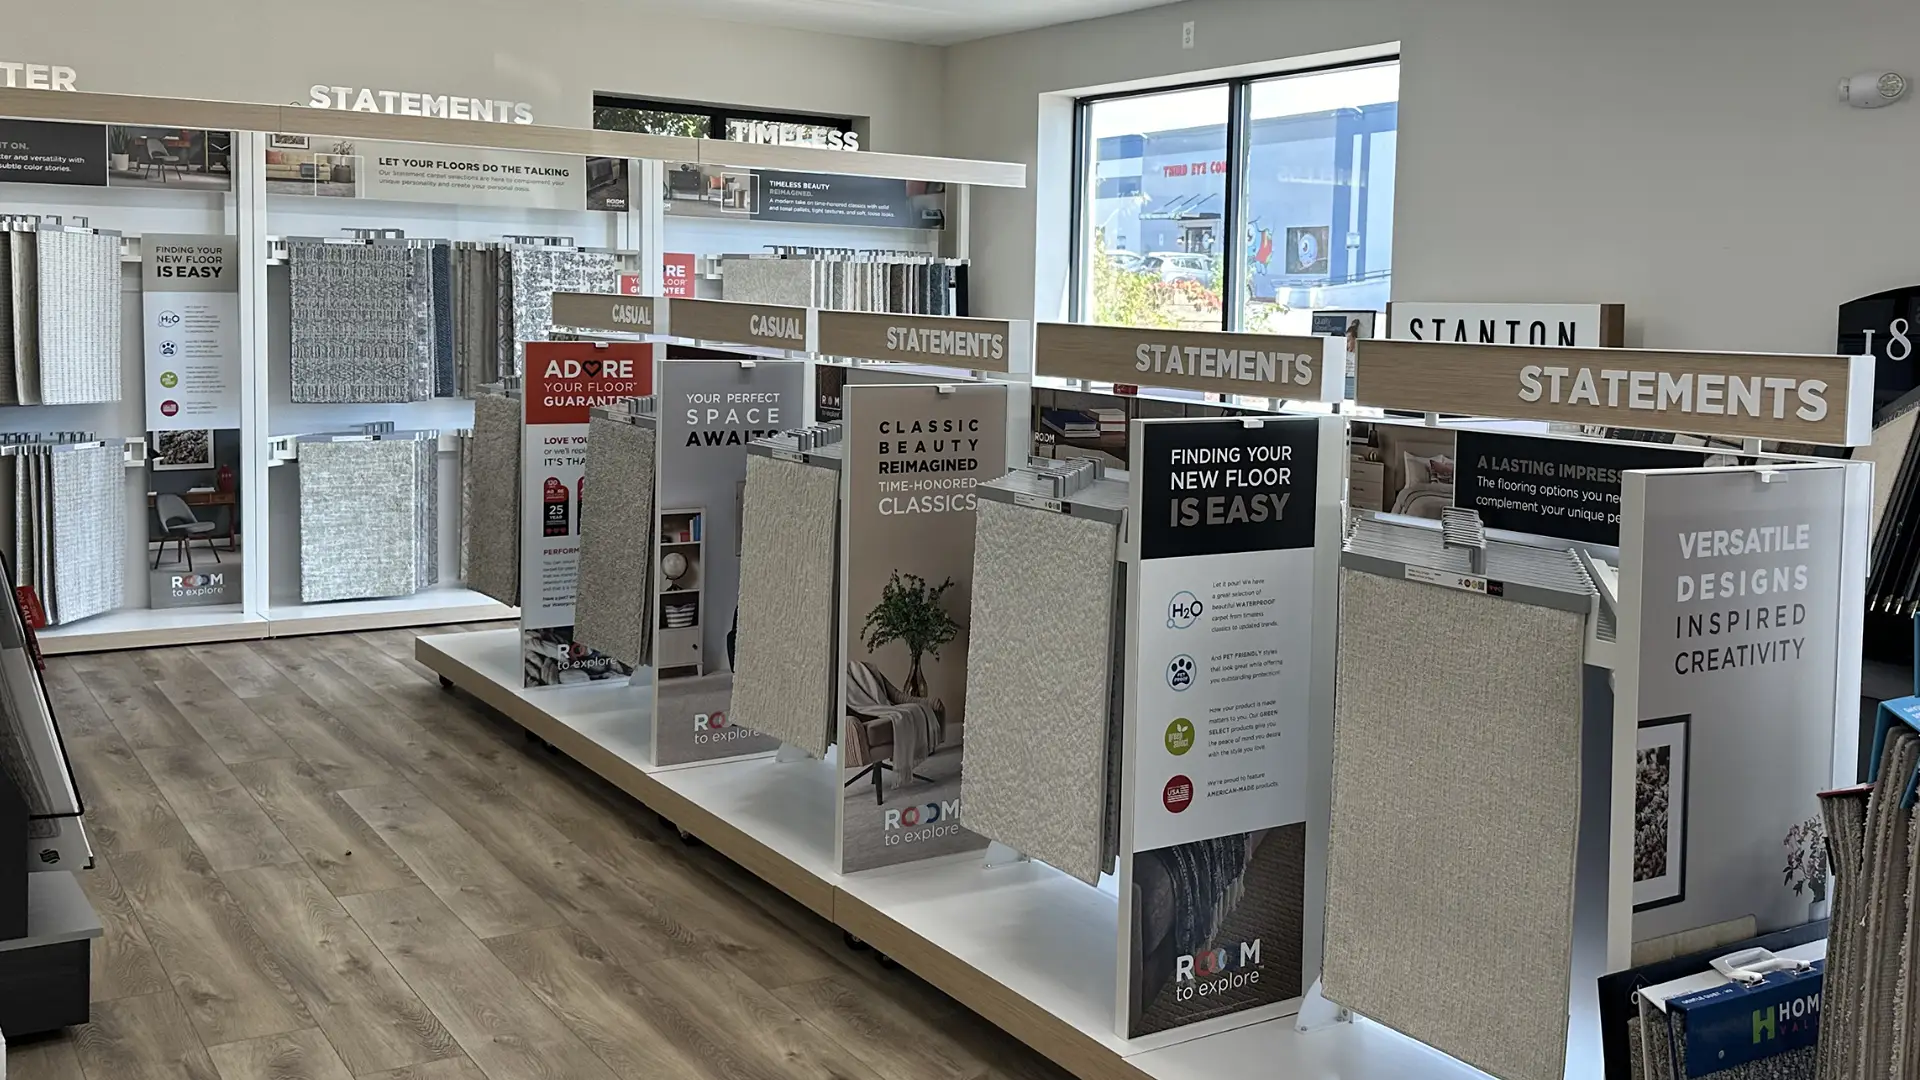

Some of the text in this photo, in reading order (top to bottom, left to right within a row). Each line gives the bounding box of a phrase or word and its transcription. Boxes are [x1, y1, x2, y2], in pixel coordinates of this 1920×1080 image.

[0, 62, 77, 92] TER
[309, 84, 534, 125] STATEMENTS
[730, 120, 859, 152] TIMELESS
[379, 157, 569, 177] LET YOUR FLOORS DO THE TALKING
[769, 180, 830, 190] TIMELESS BEAUTY
[157, 266, 223, 278] IS EASY
[612, 304, 651, 325] CASUAL
[750, 315, 803, 339] CASUAL
[1410, 317, 1576, 346] STANTON
[887, 326, 1003, 360] STATEMENTS
[1136, 343, 1312, 386] STATEMENTS
[544, 382, 583, 392] YOUR
[1518, 365, 1828, 422] STATEMENTS
[544, 396, 634, 407] GUARANTE
[686, 392, 780, 404] YOUR PERFECT
[686, 408, 780, 425] SPACE
[879, 419, 979, 434] CLASSIC
[879, 439, 979, 454] BEAUTY
[1171, 446, 1292, 465] FINDING YOUR
[544, 458, 563, 466] IT'S
[879, 458, 978, 474] REIMAGINED
[1477, 455, 1488, 469] A
[1491, 456, 1555, 476] LASTING
[878, 478, 977, 493] TIME-HONORED
[1170, 467, 1291, 490] NEW FLOOR
[1477, 476, 1621, 504] The flooring options you ne
[549, 505, 564, 515] 25
[878, 494, 977, 516] CLASSICS
[1170, 493, 1291, 527] IS EASY
[1476, 495, 1539, 512] complement
[1541, 504, 1565, 516] your
[1568, 507, 1604, 521] unique
[1679, 524, 1810, 559] VERSATILE
[172, 586, 224, 597] to explore
[1677, 565, 1808, 602] DESIGNS
[1172, 600, 1203, 619] H2O
[1236, 599, 1276, 608] WATERPROOF
[1676, 603, 1806, 639] INSPIRED
[557, 642, 592, 659] RO
[1675, 638, 1805, 675] CREATIVITY
[557, 656, 617, 670] to explore
[694, 728, 760, 745] to explore
[1207, 785, 1255, 797] AMERICAN-MADE
[884, 799, 960, 831] ROOM
[885, 824, 959, 846] to explore
[1176, 939, 1261, 982] ROOM
[1176, 970, 1259, 1002] to explore
[1779, 993, 1819, 1022] HOM
